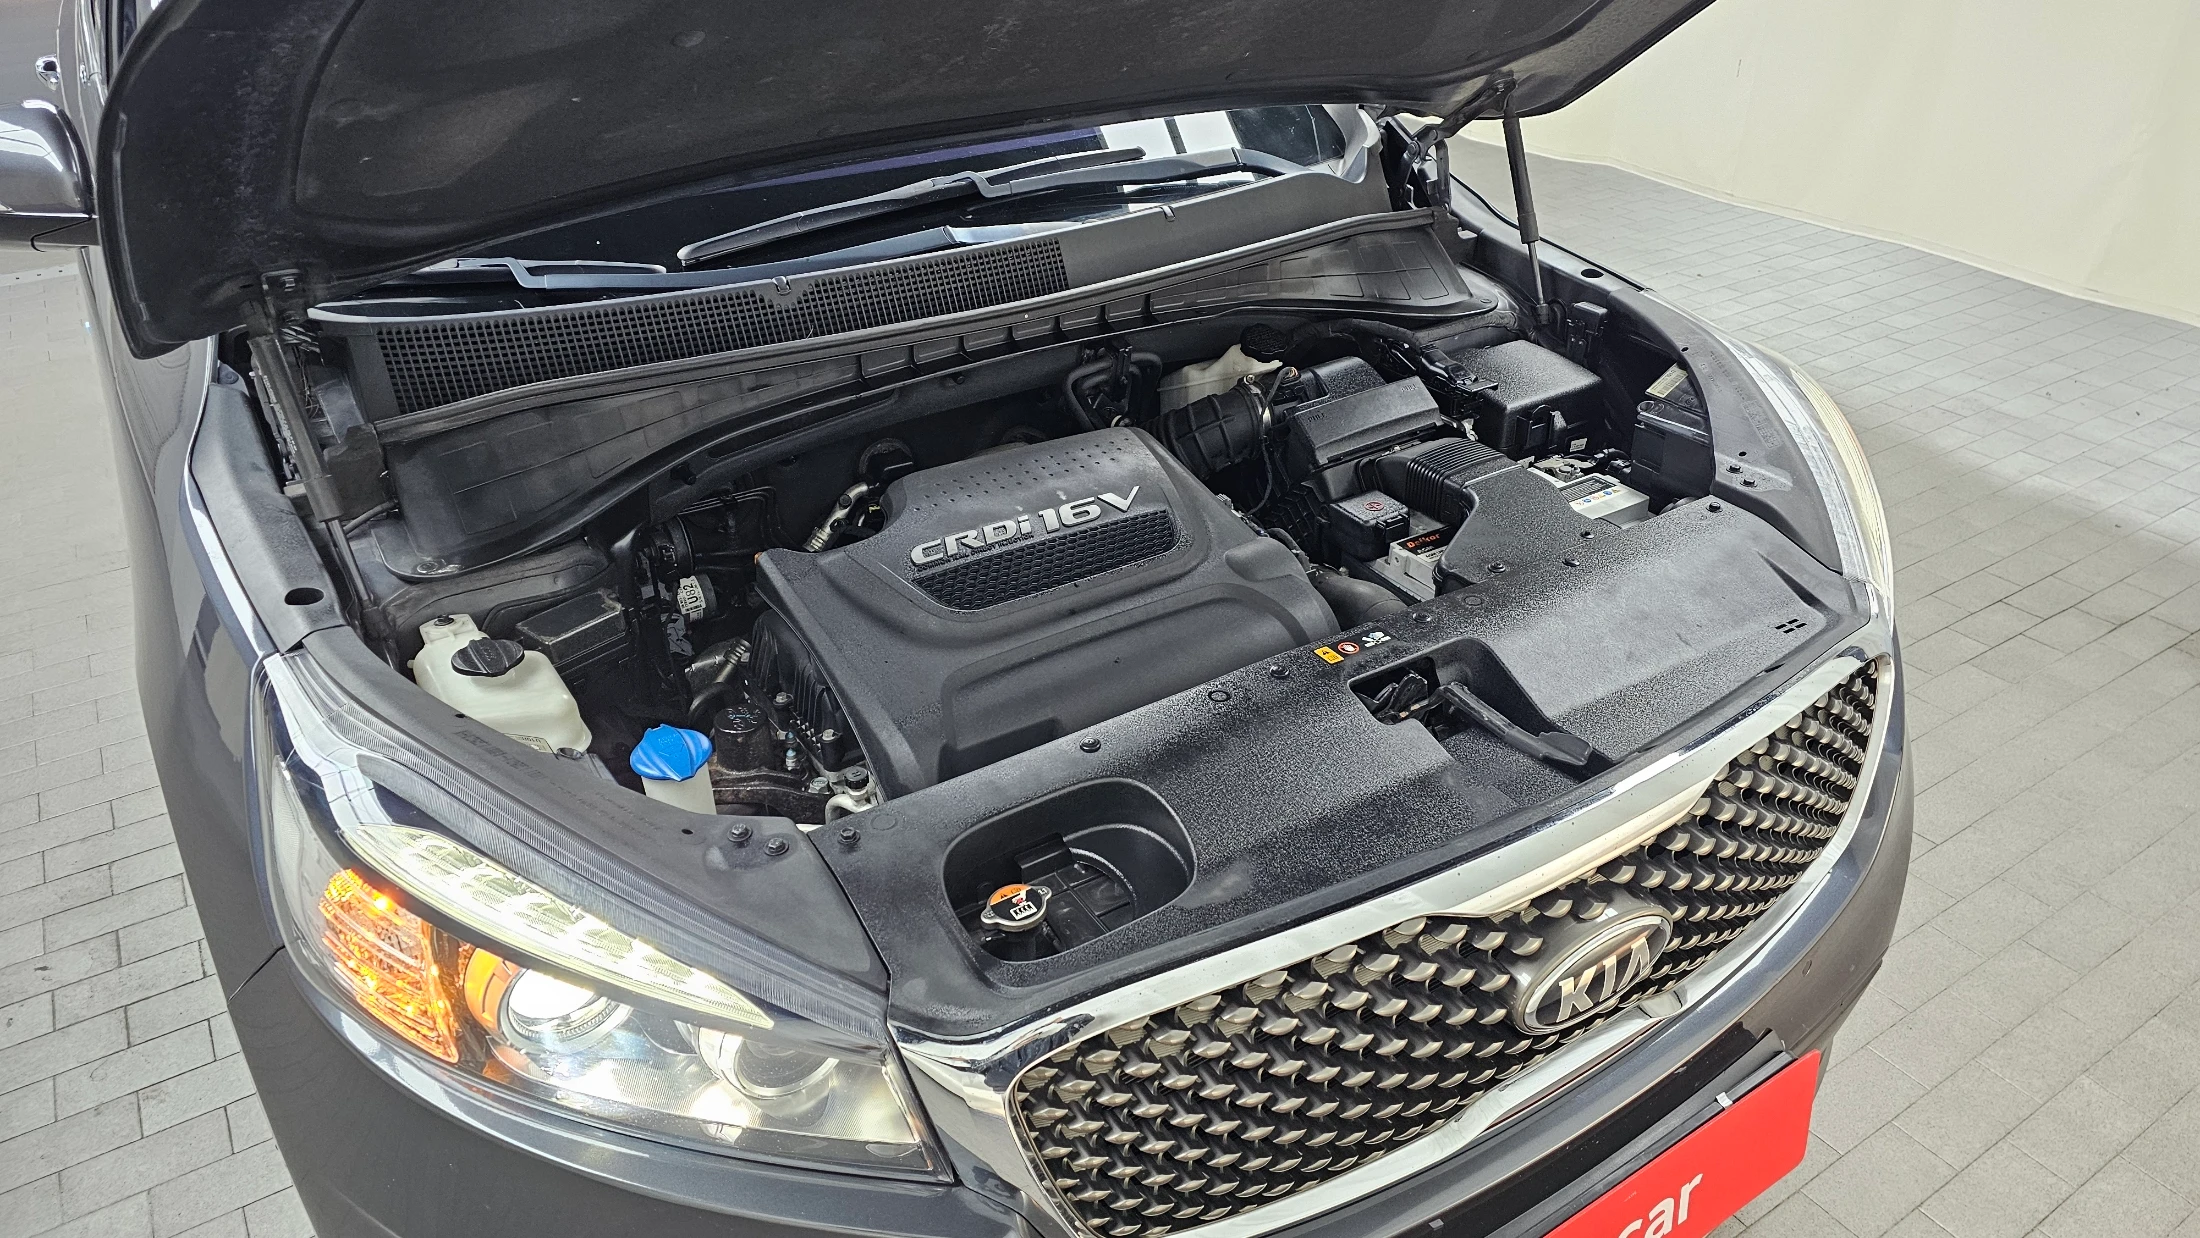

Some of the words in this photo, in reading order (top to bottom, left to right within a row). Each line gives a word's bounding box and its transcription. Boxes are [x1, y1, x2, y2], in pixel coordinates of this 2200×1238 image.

[910, 516, 1032, 566] CRDi
[1038, 485, 1140, 533] 16V
[682, 583, 699, 604] U82
[1556, 936, 1650, 1023] KIA
